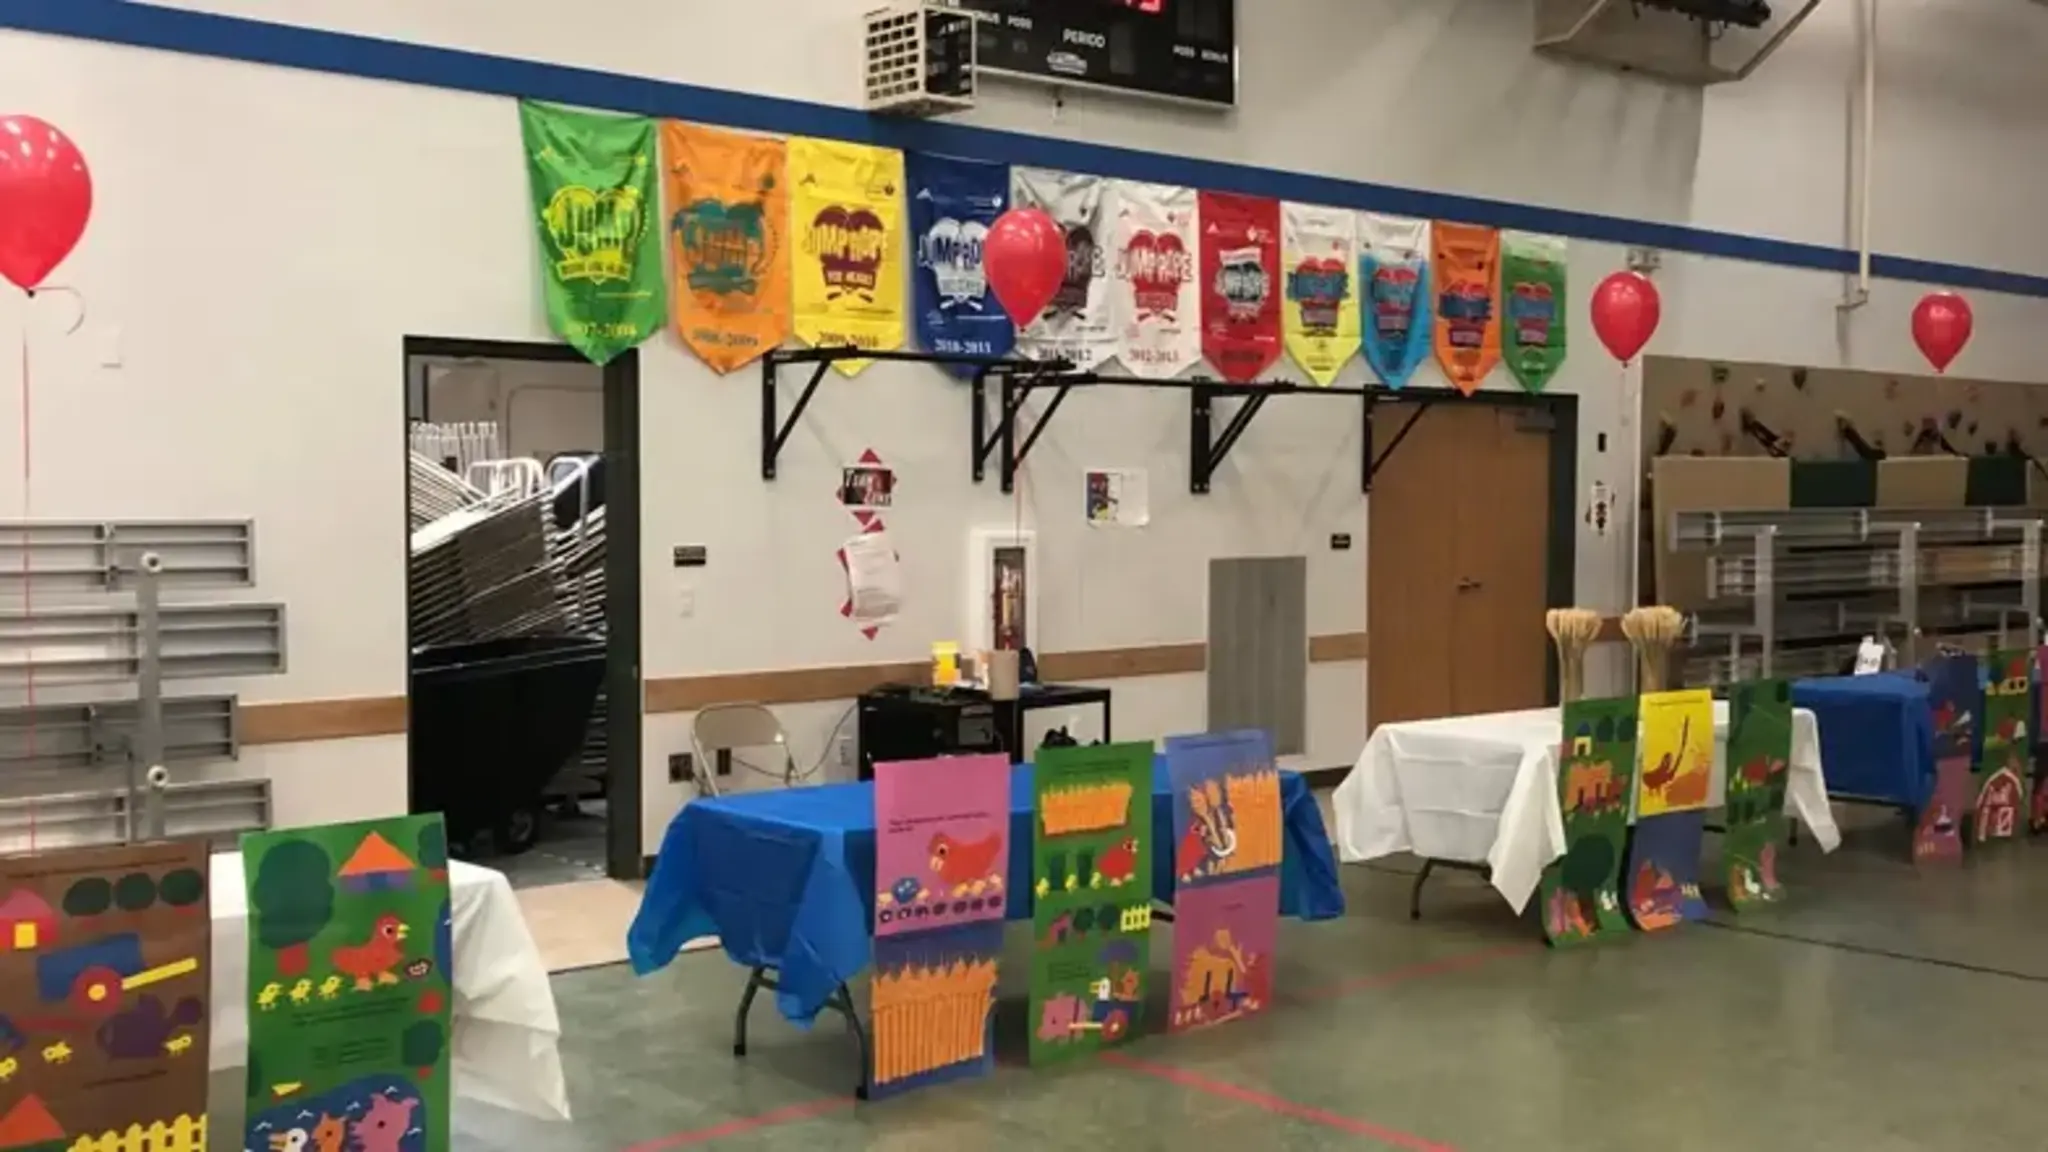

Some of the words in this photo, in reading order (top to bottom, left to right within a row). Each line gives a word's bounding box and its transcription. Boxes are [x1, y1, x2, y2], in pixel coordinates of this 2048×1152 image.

[917, 233, 961, 271] JUMP
[1115, 246, 1155, 282] JUMP
[1156, 249, 1193, 283] ROPE
[934, 338, 991, 354] 2010-2011
